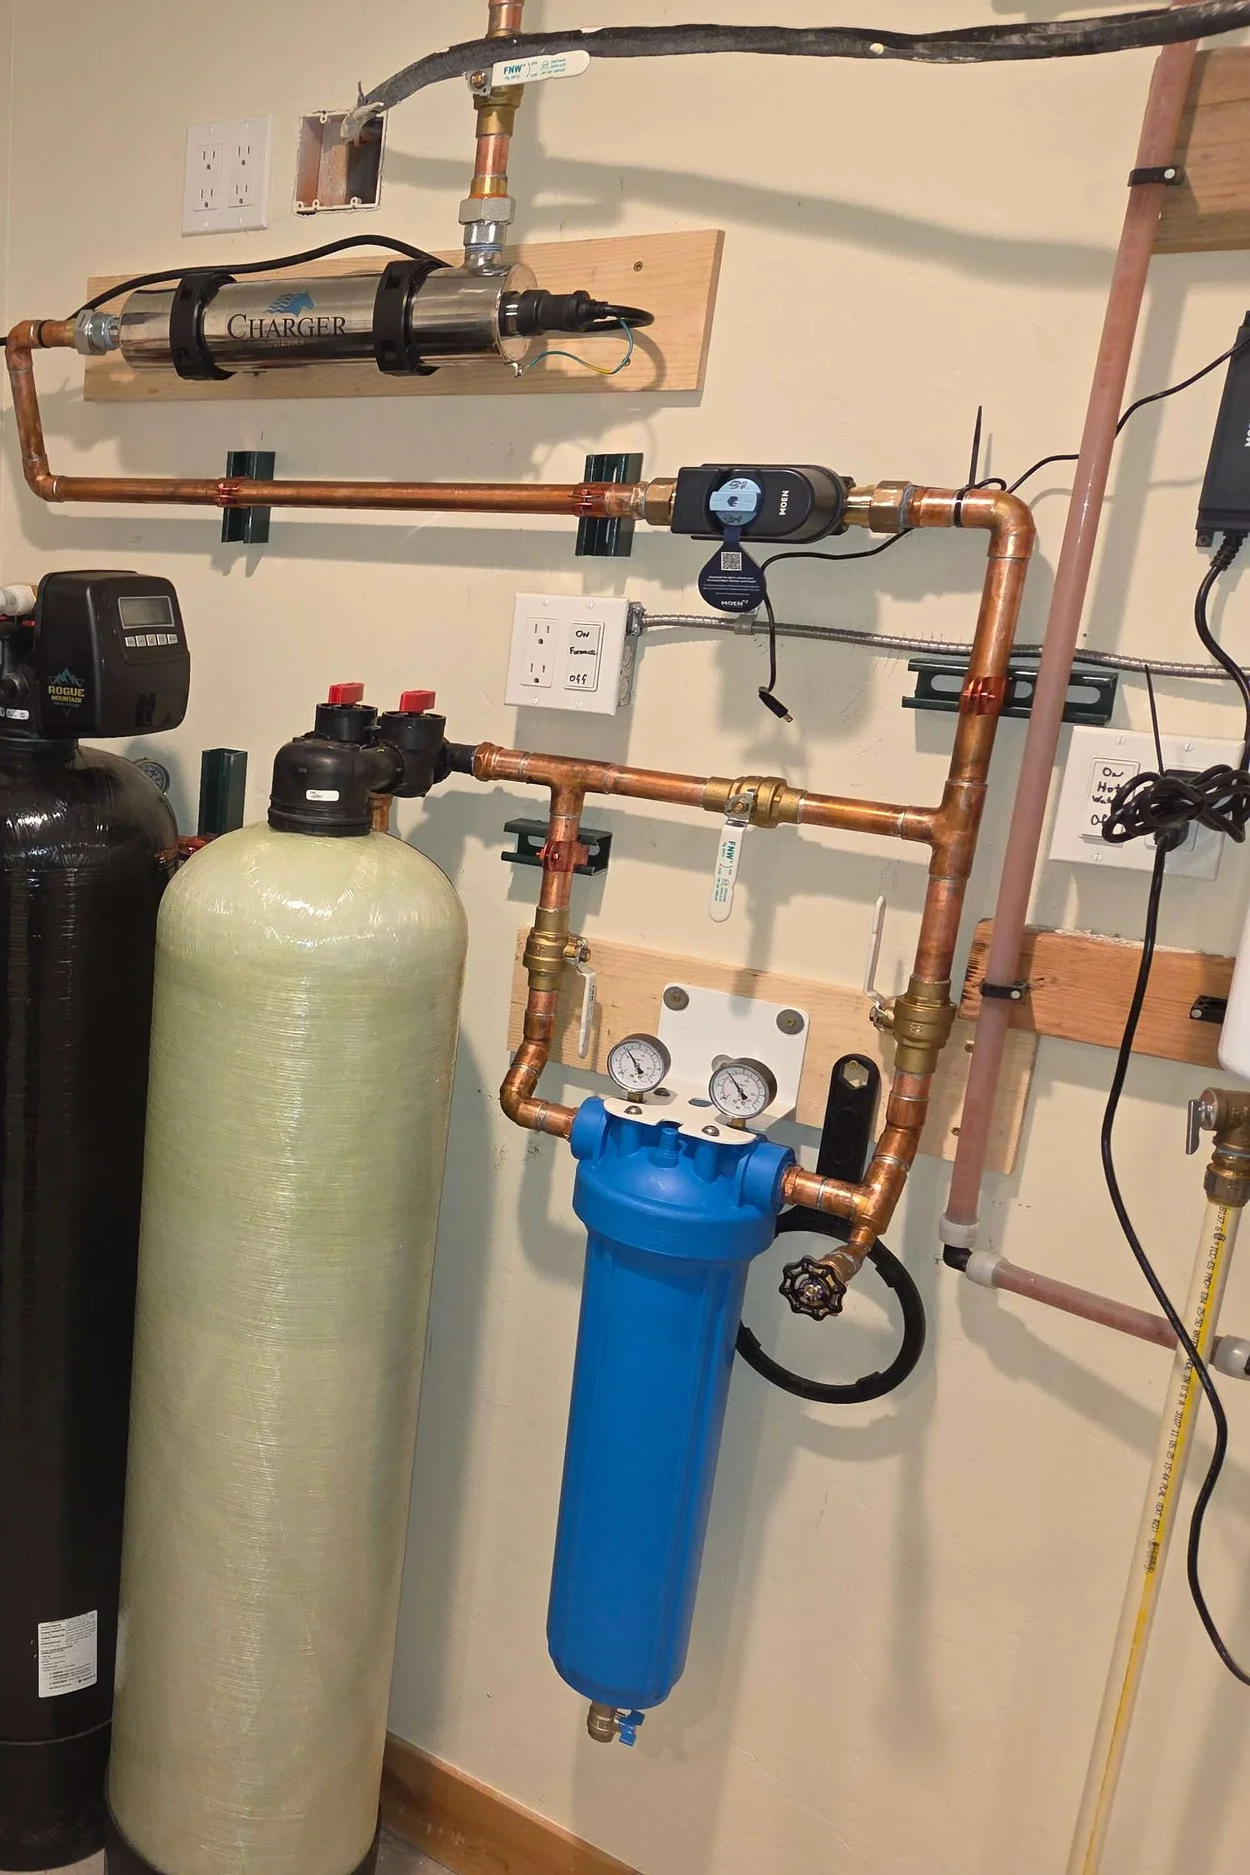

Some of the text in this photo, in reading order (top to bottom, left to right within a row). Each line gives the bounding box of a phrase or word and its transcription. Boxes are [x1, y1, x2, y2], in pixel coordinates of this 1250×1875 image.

[503, 64, 522, 75] FNW
[779, 490, 790, 516] MOEN
[48, 685, 85, 698] ROGUE
[51, 694, 82, 704] MOUNTAIN
[726, 840, 736, 860] FNW
